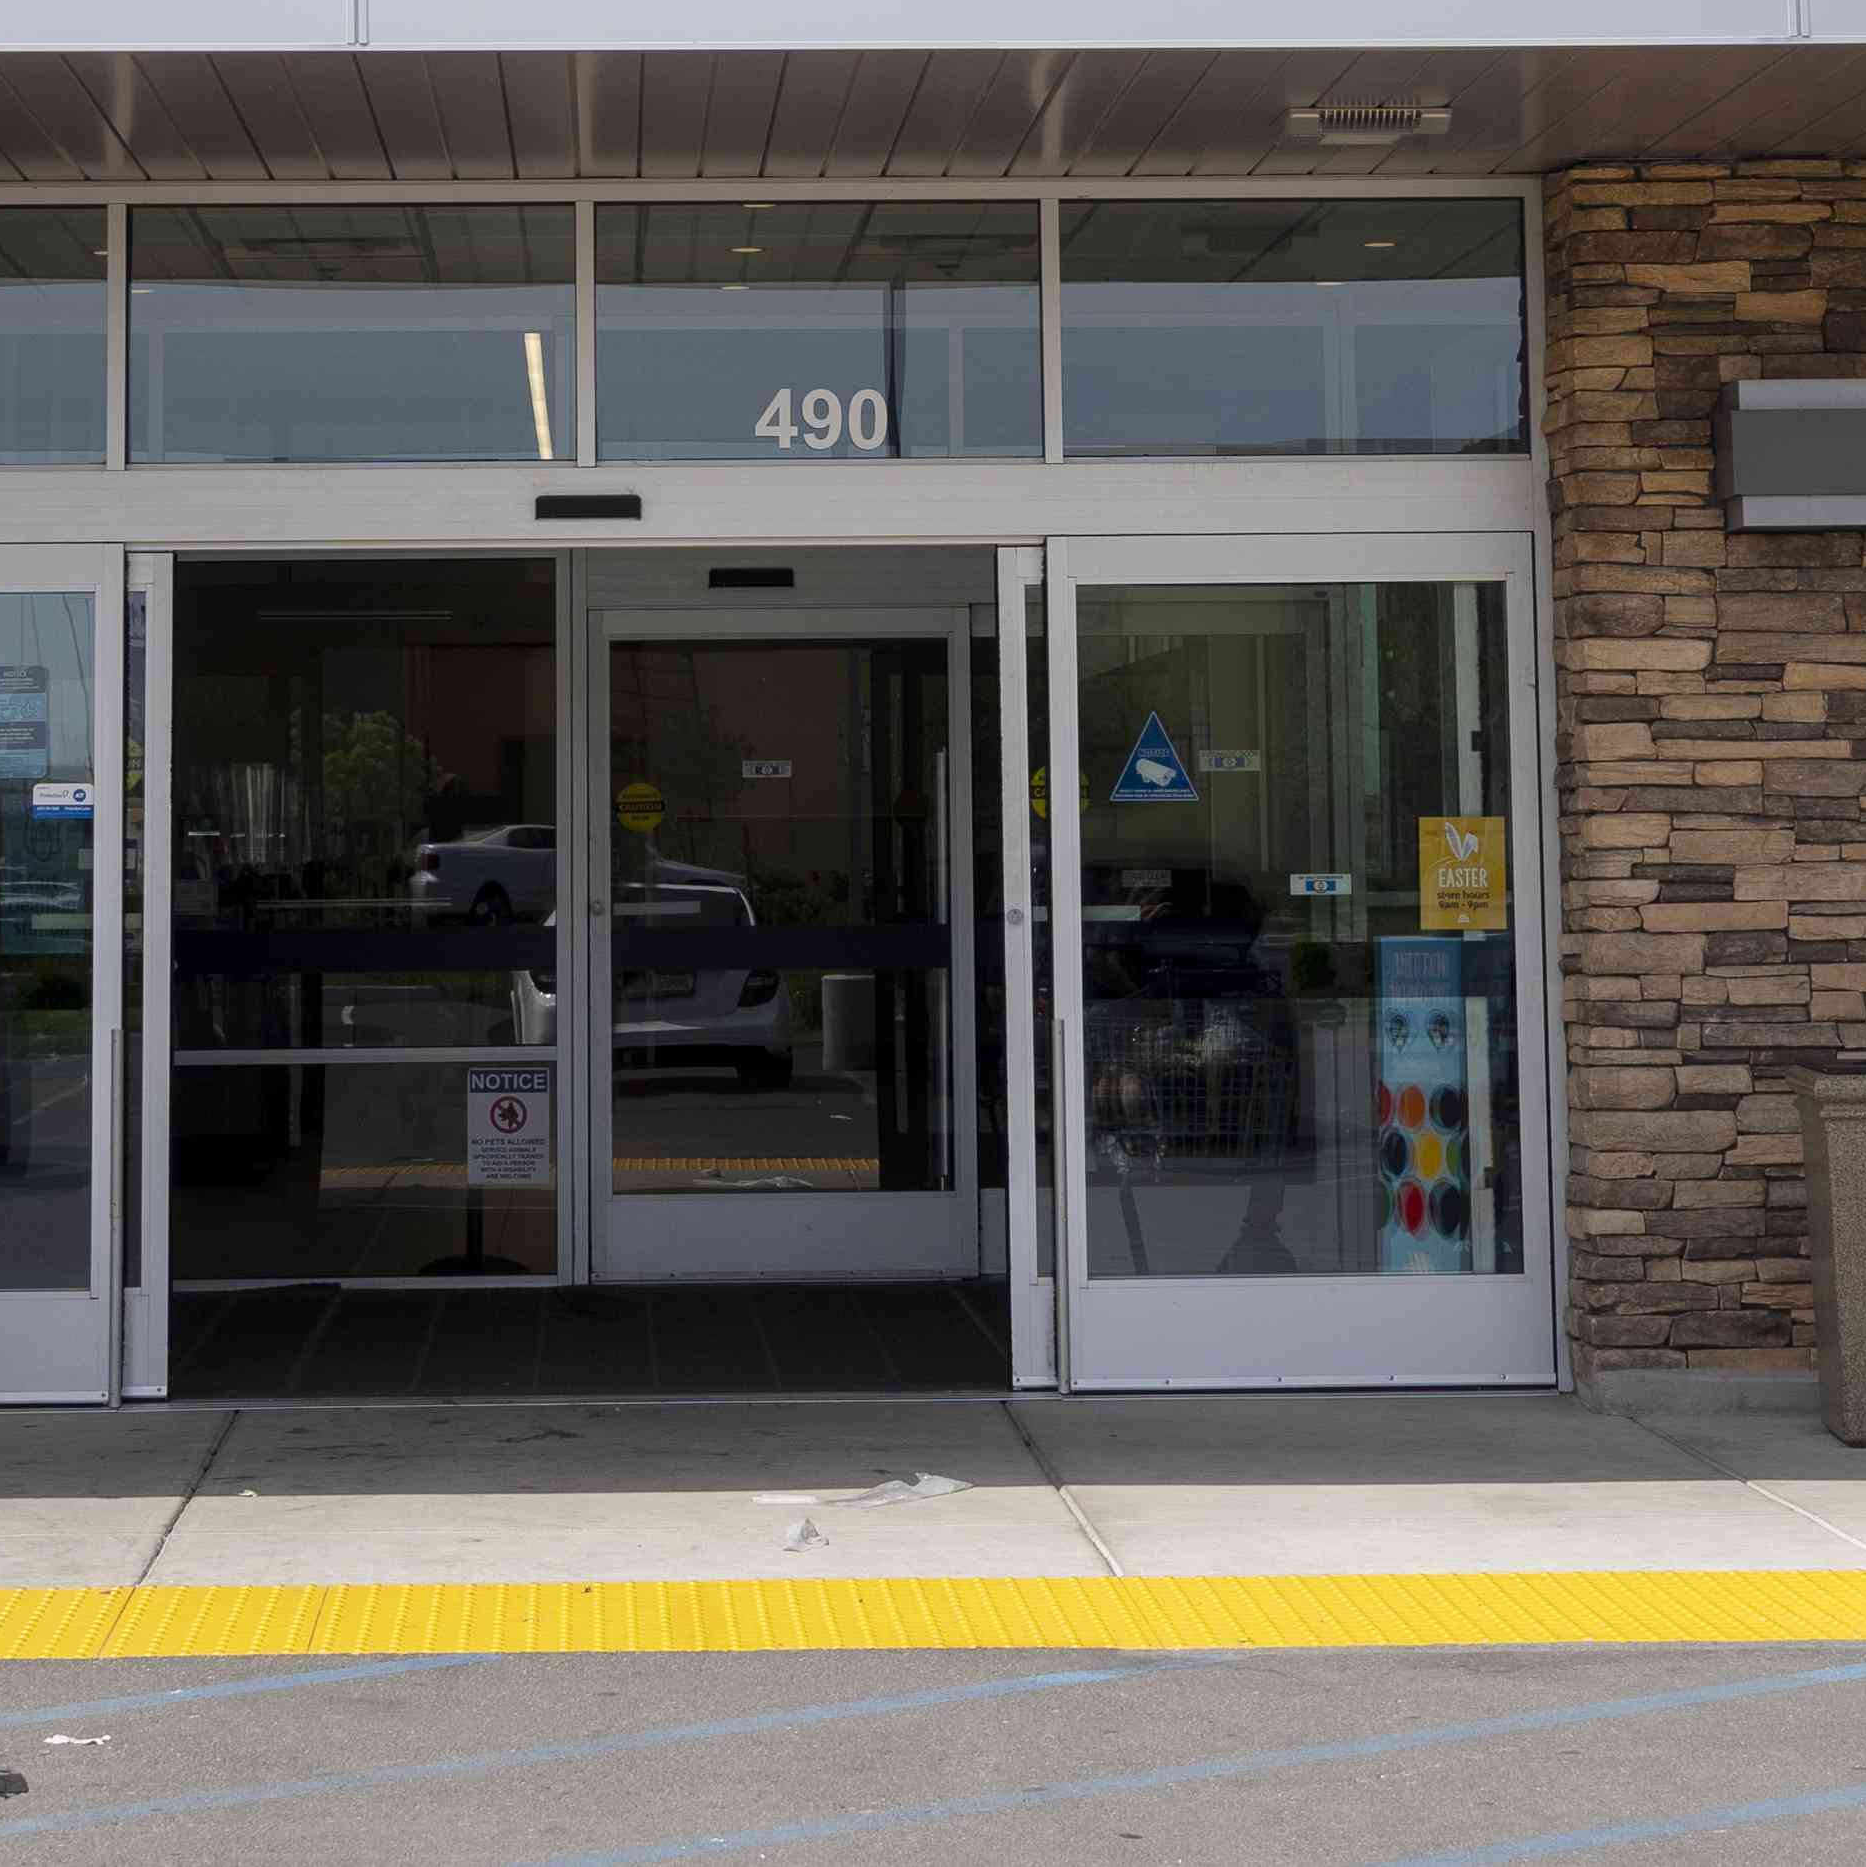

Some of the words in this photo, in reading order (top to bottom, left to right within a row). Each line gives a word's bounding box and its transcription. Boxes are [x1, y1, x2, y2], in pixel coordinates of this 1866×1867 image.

[755, 388, 888, 450] 490
[1438, 868, 1488, 888] EASTER
[1462, 890, 1490, 899] hours
[1438, 900, 1460, 909] 9am
[1467, 900, 1489, 910] 9pm
[471, 1073, 546, 1090] NOTICE
